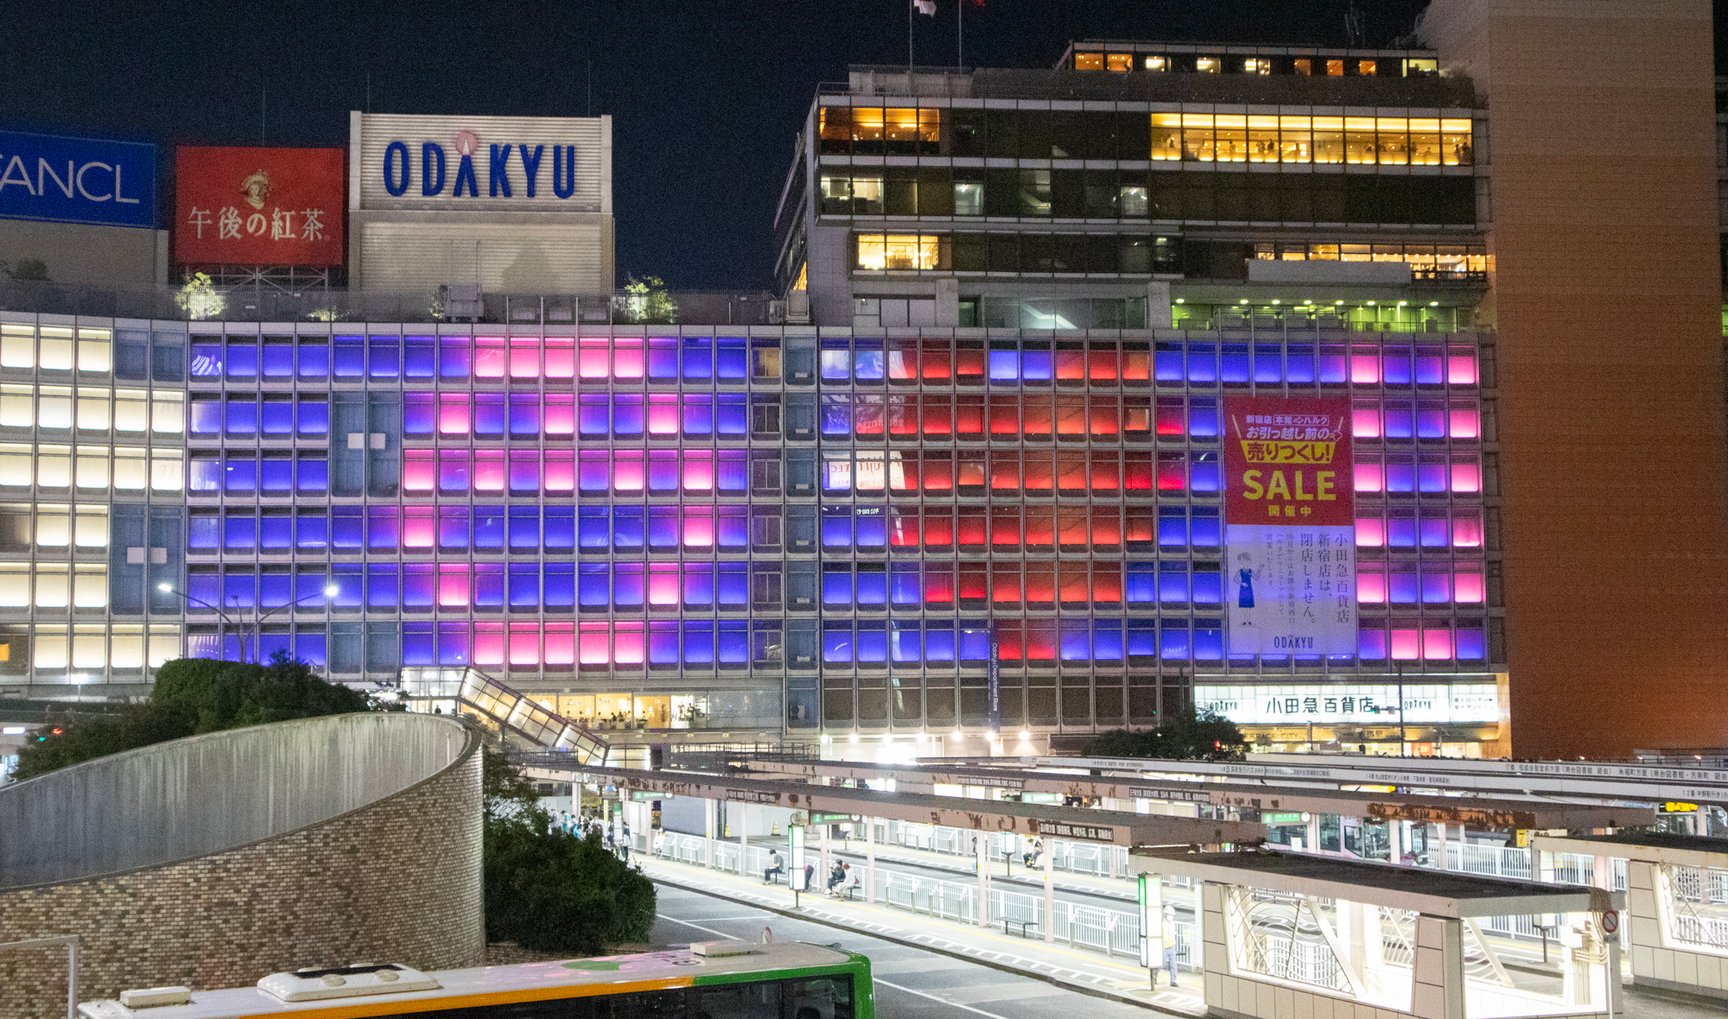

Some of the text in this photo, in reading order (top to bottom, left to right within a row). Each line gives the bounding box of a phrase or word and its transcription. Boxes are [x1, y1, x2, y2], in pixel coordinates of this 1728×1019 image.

[0, 154, 140, 204] ANCL
[383, 131, 575, 199] ODAKYU
[187, 205, 326, 242] 午後の紅茶
[1247, 426, 1330, 440] お引っ越し前の
[1247, 442, 1331, 461] 売りつくし!
[1242, 469, 1337, 501] SALE
[1268, 504, 1312, 517] 開催中
[1301, 533, 1317, 624] 閉店しません。
[1319, 533, 1333, 597] 新宿店は、
[1335, 533, 1349, 623] 小田急百貨店
[1273, 636, 1314, 649] ODAKYU
[1266, 696, 1375, 714] 小田急百貨店
[1404, 699, 1431, 711] ODAKYU
